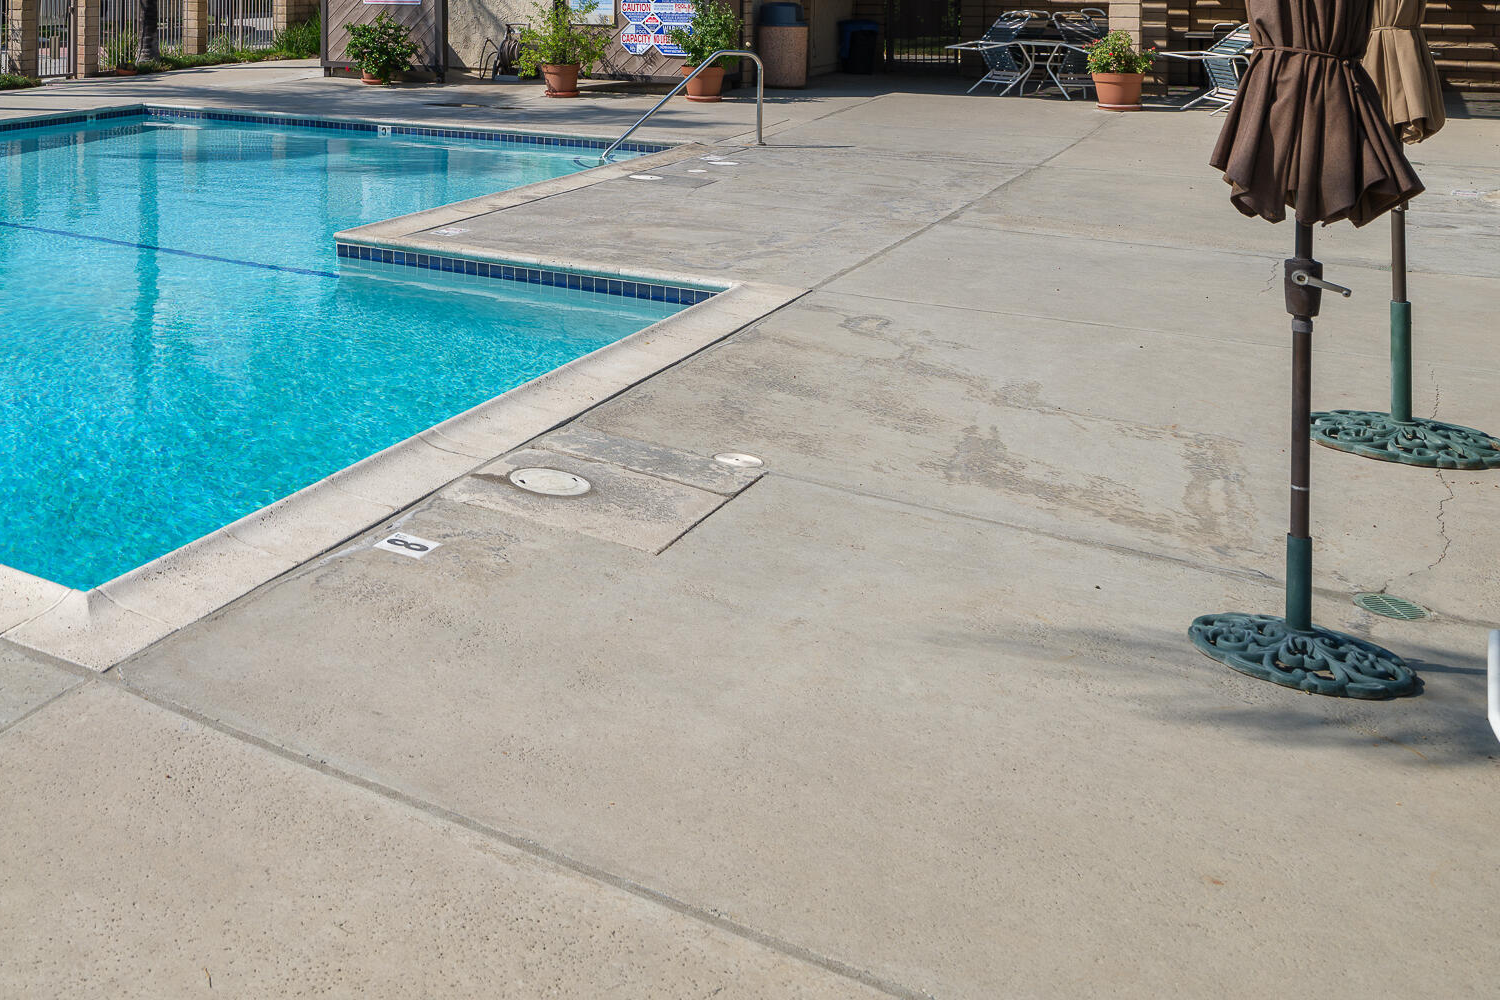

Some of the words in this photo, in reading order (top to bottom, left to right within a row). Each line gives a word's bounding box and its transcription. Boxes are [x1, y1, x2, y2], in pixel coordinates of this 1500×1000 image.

[621, 3, 652, 12] CAUTION
[621, 34, 652, 43] CAPACITY
[653, 34, 661, 44] NO
[386, 538, 429, 552] 8
